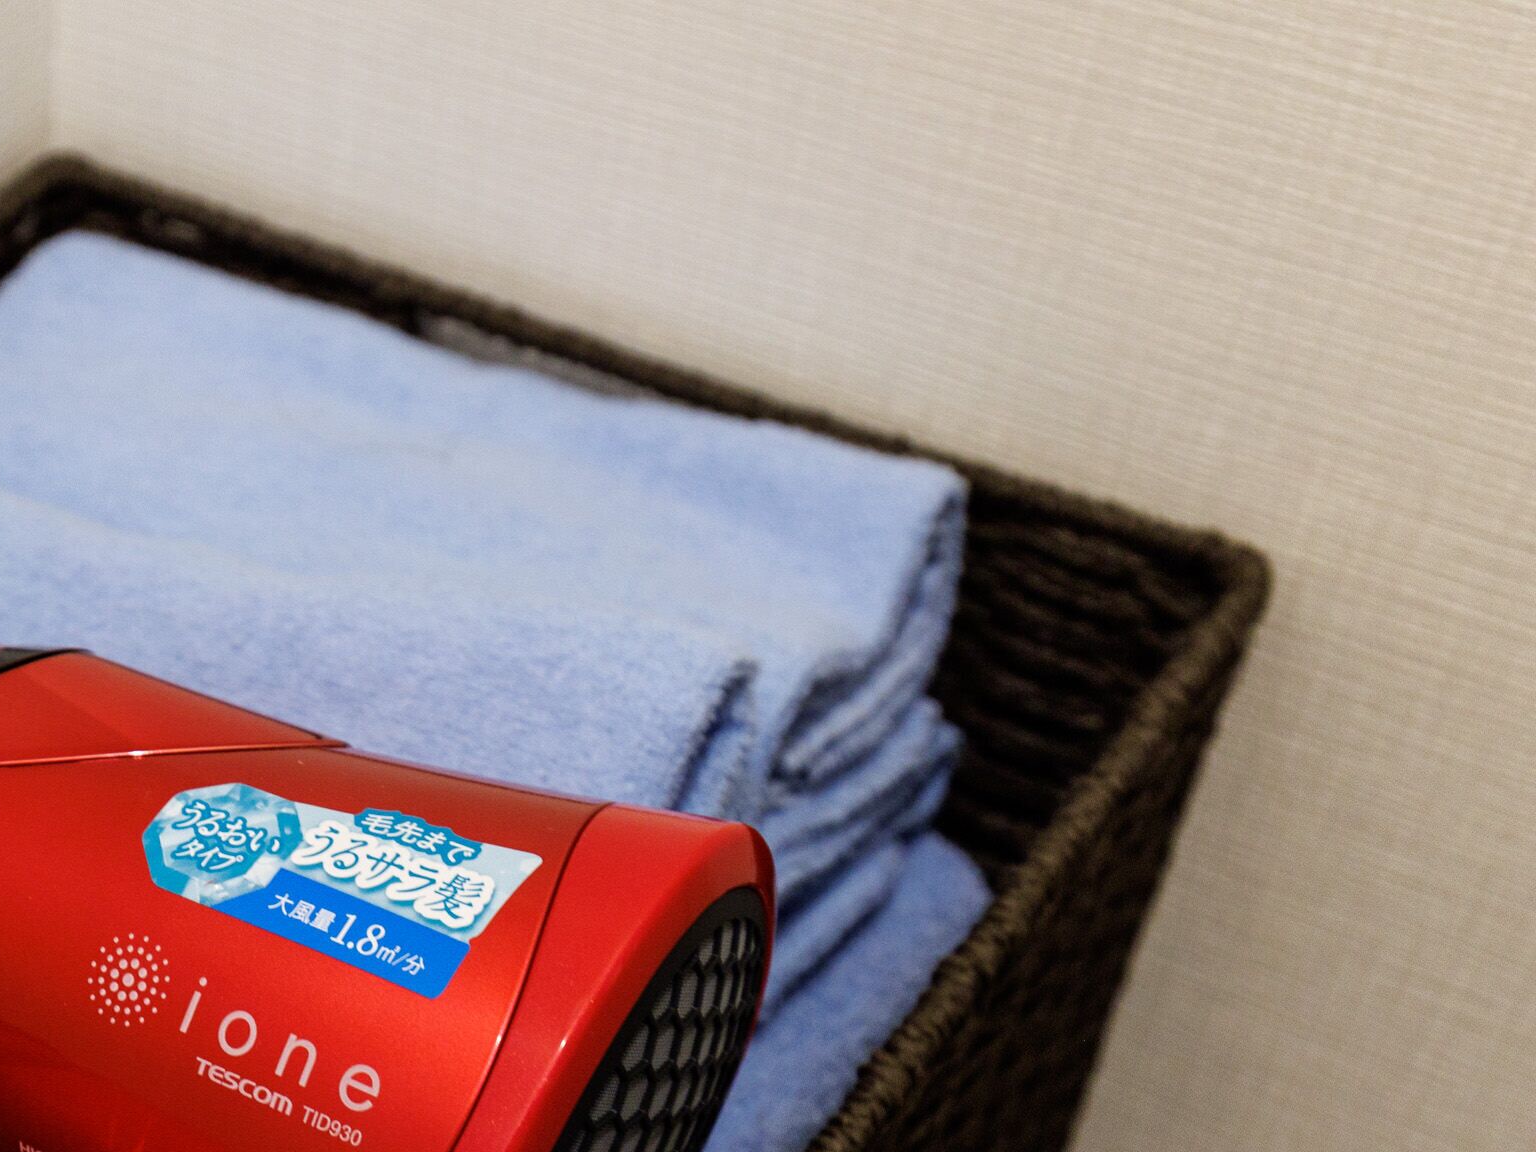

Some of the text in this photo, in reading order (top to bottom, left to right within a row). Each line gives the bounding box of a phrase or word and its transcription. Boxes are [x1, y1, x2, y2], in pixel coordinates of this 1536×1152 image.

[175, 801, 281, 852] うるおい
[360, 812, 476, 864] 毛先まで
[175, 837, 245, 871] タイプ
[302, 823, 488, 922] うるサラ髪
[179, 976, 381, 1112] ione
[302, 1104, 363, 1148] TID930
